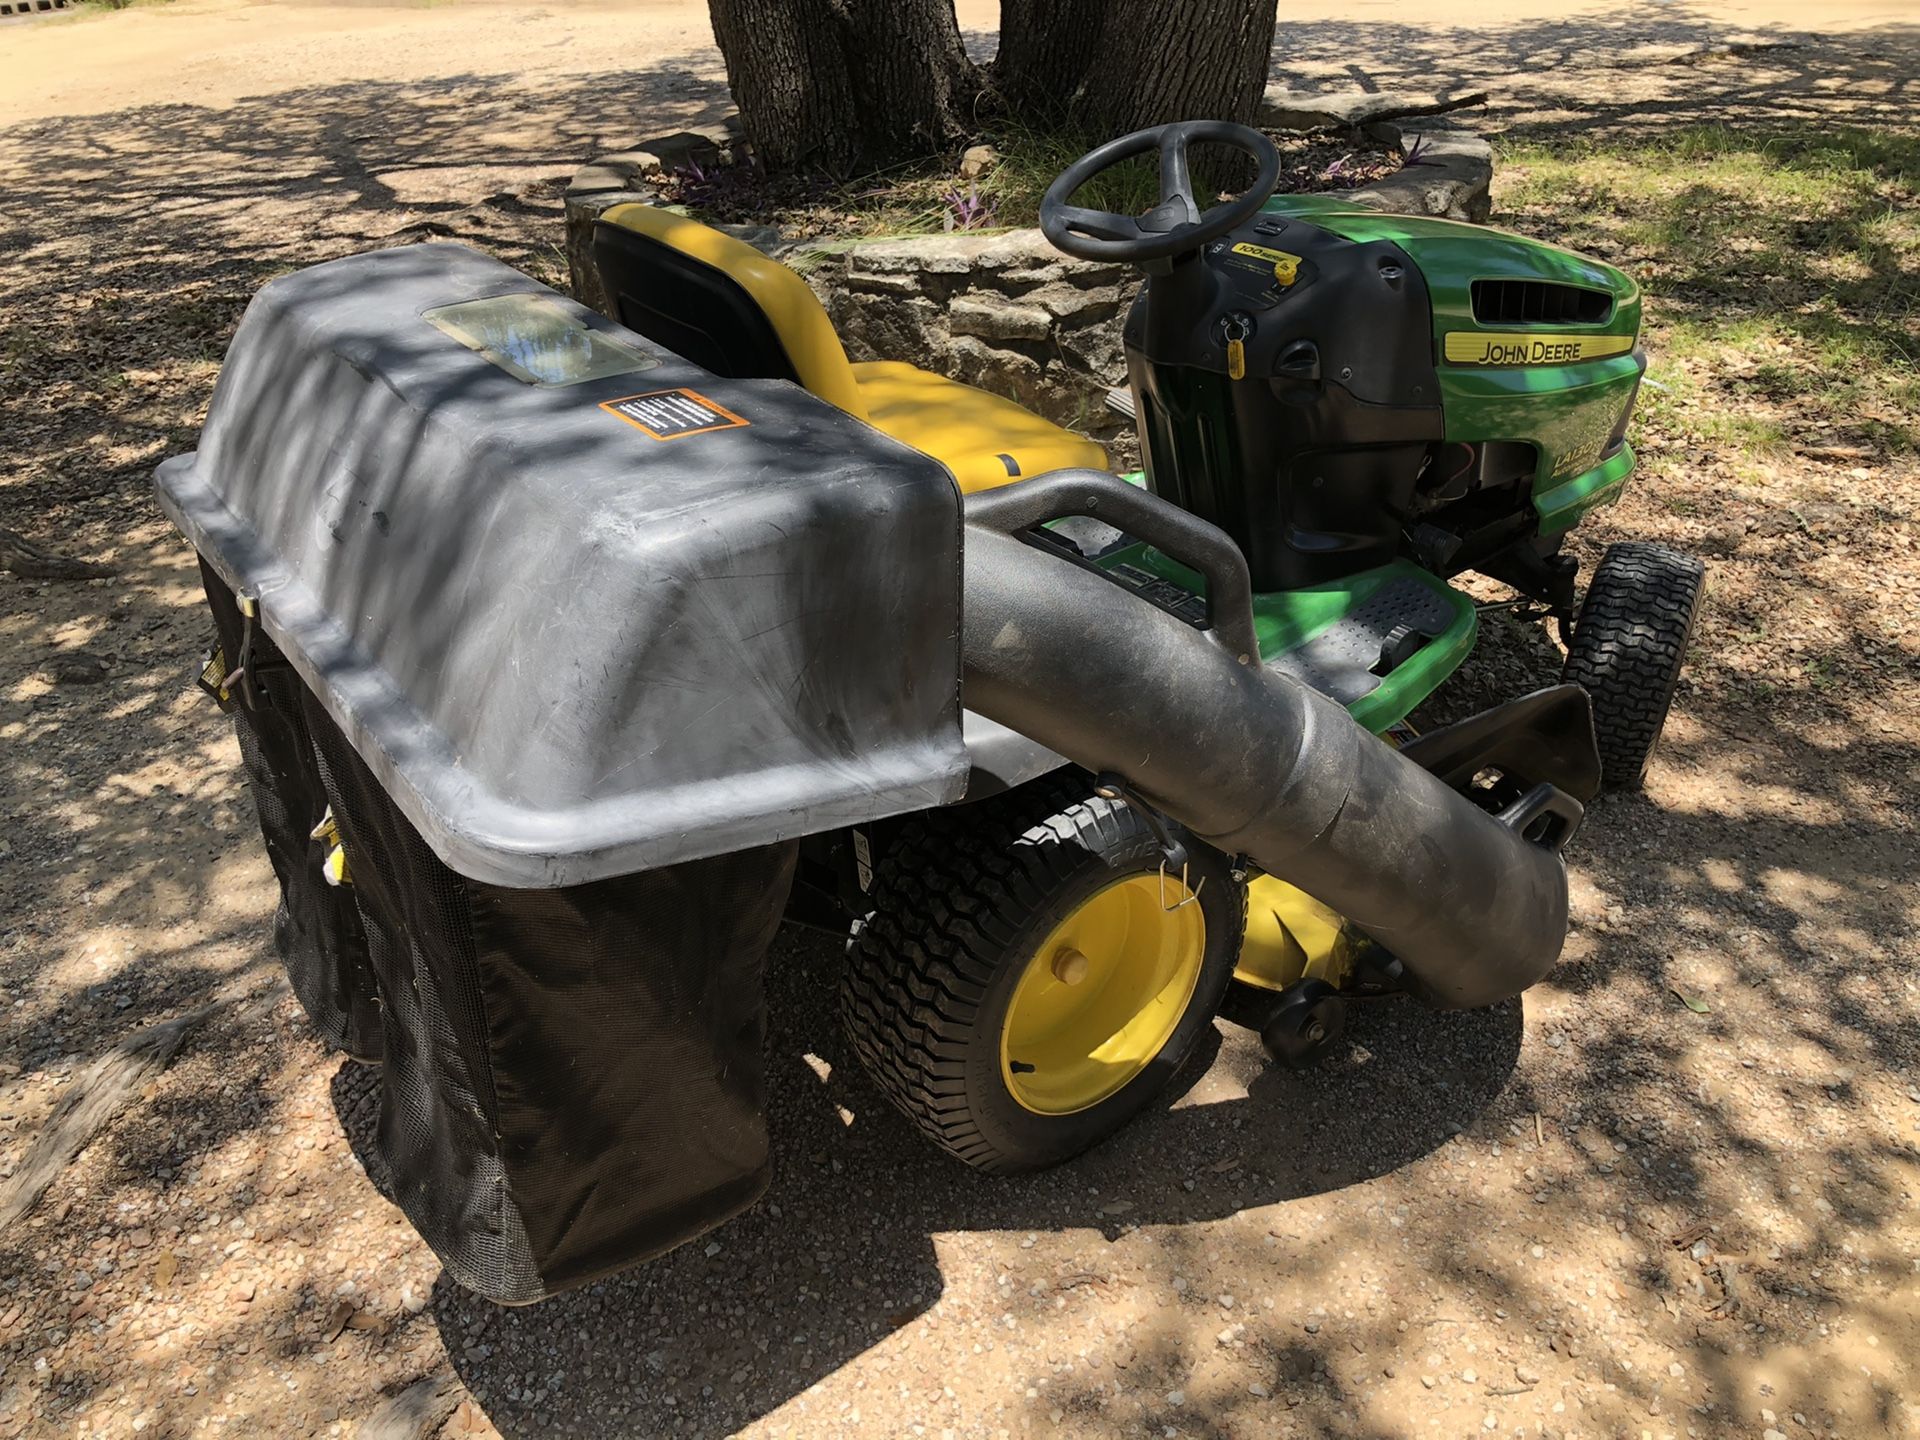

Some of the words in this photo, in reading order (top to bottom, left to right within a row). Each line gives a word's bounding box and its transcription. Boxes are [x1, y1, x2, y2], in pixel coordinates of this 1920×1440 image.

[1239, 245, 1263, 255] 100
[1479, 341, 1529, 362] JOHN
[1532, 341, 1582, 362] DEERE
